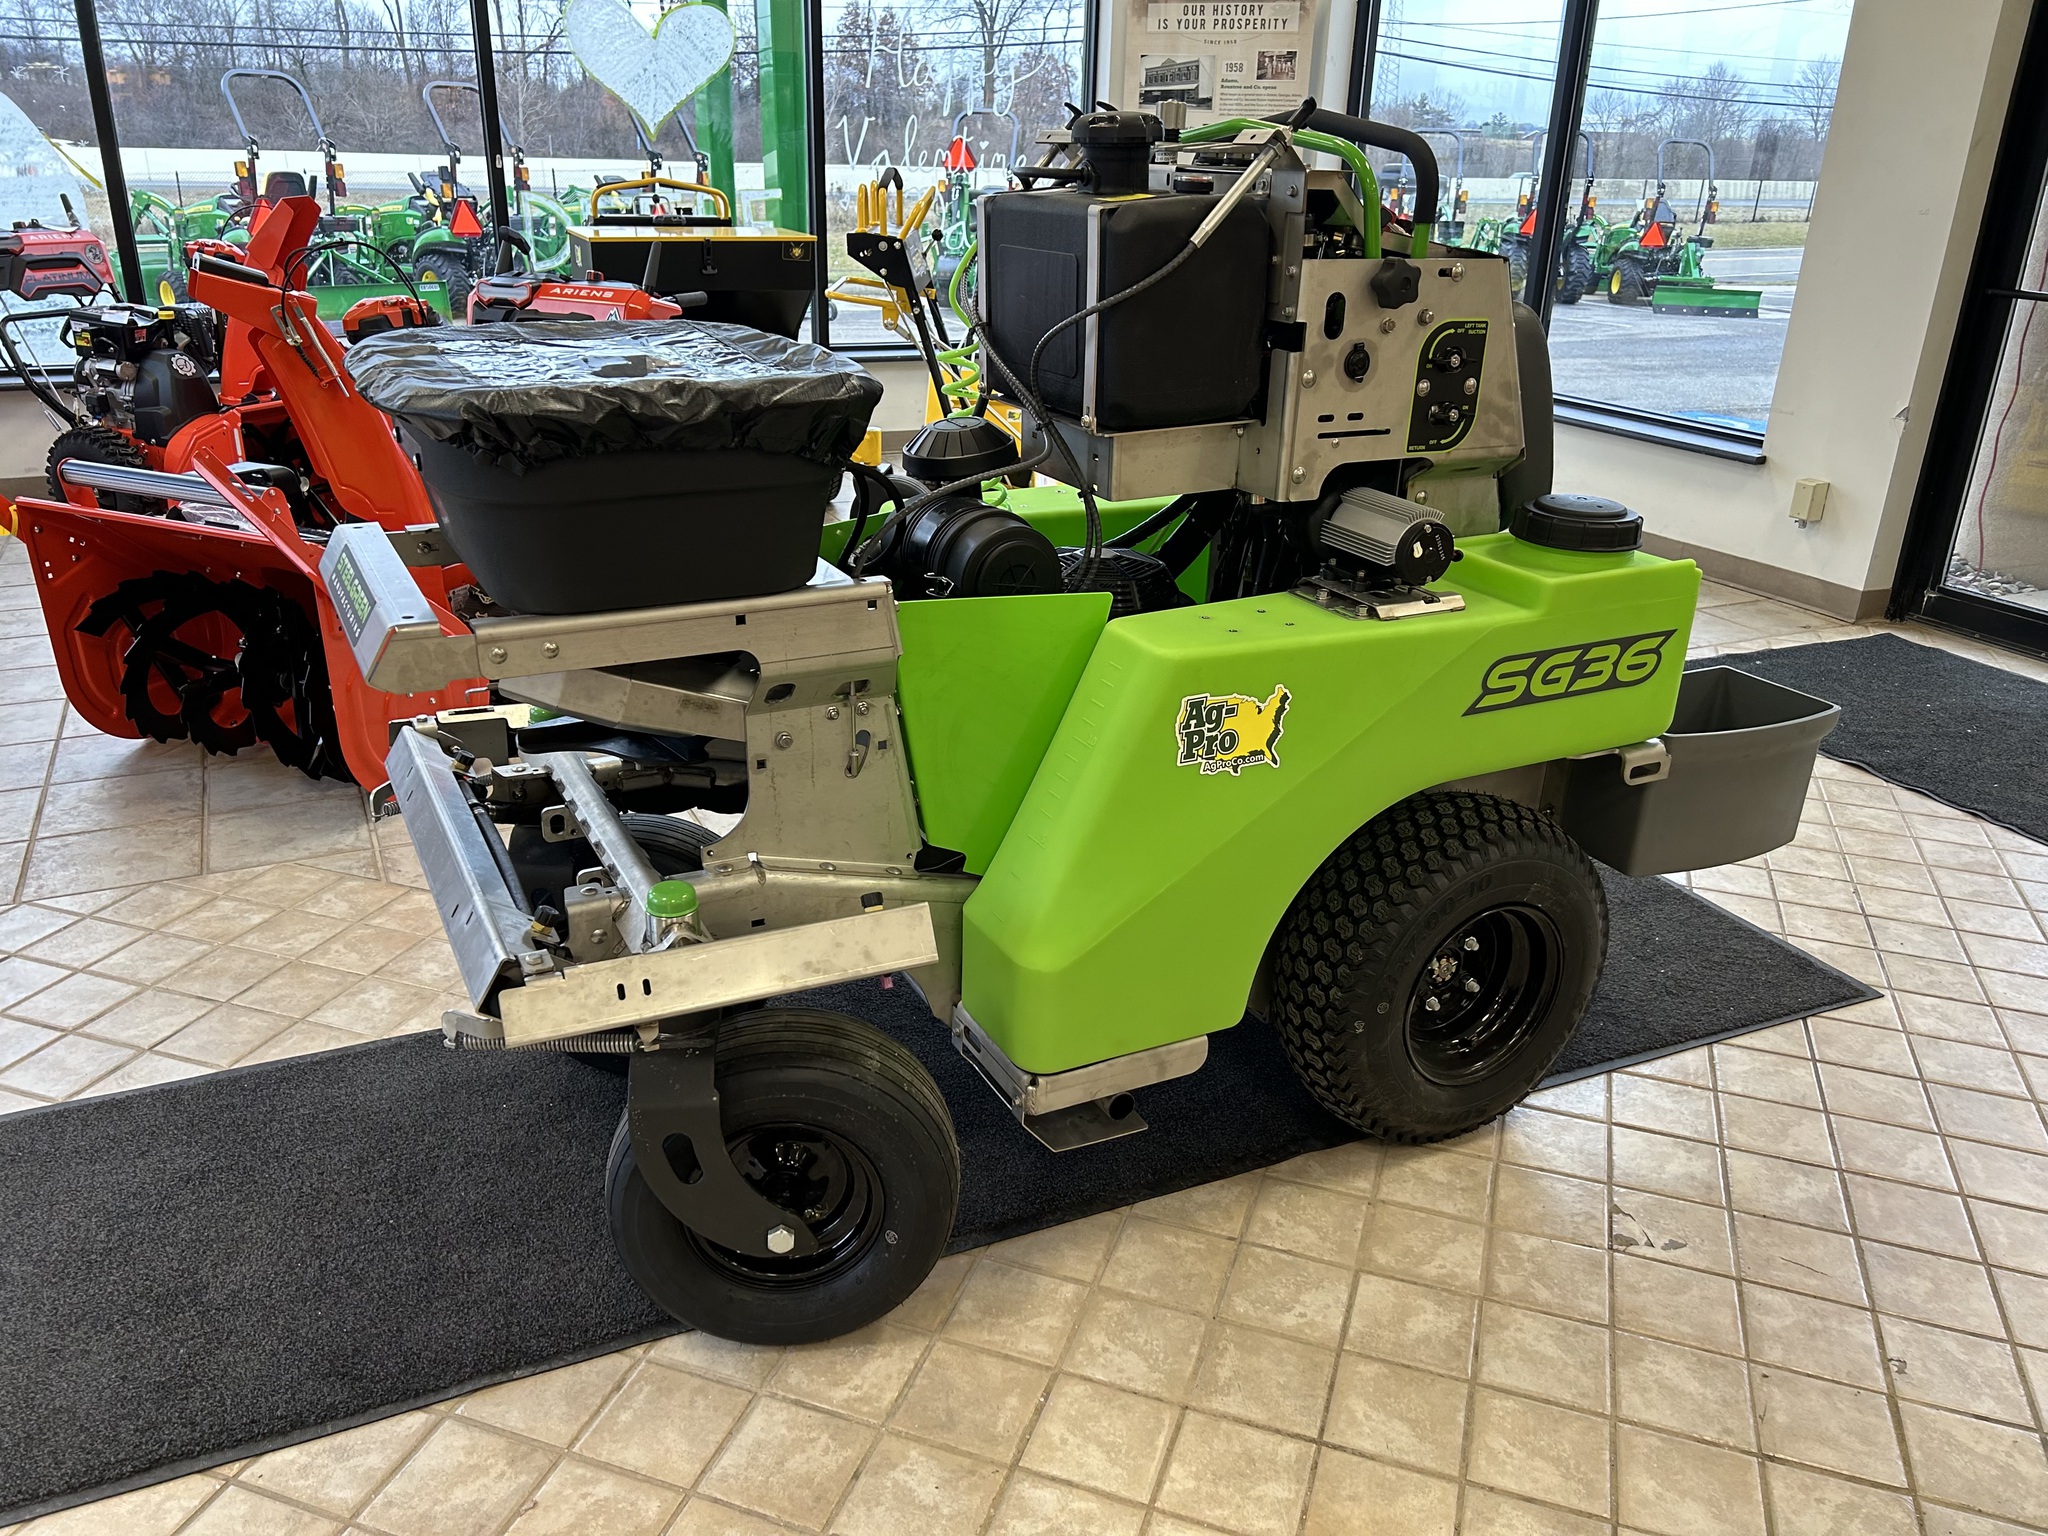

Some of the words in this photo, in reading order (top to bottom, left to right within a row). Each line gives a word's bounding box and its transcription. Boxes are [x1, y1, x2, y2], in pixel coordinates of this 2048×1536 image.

[1183, 4, 1206, 16] OUR
[1212, 4, 1264, 16] HISTORY
[1158, 18, 1169, 30] IS
[1176, 18, 1206, 30] YOUR
[1213, 18, 1288, 30] PROSPERITY
[862, 3, 1050, 117] Happy
[1225, 62, 1244, 73] 1958
[29, 232, 82, 241] ARIENS
[25, 271, 91, 284] PLATINUM
[549, 287, 615, 299] ARIENS
[331, 572, 361, 638] MANUFACTURING
[1474, 635, 1667, 709] SG36
[1180, 728, 1239, 764] Pro
[1204, 754, 1265, 773] AgProCo.com
